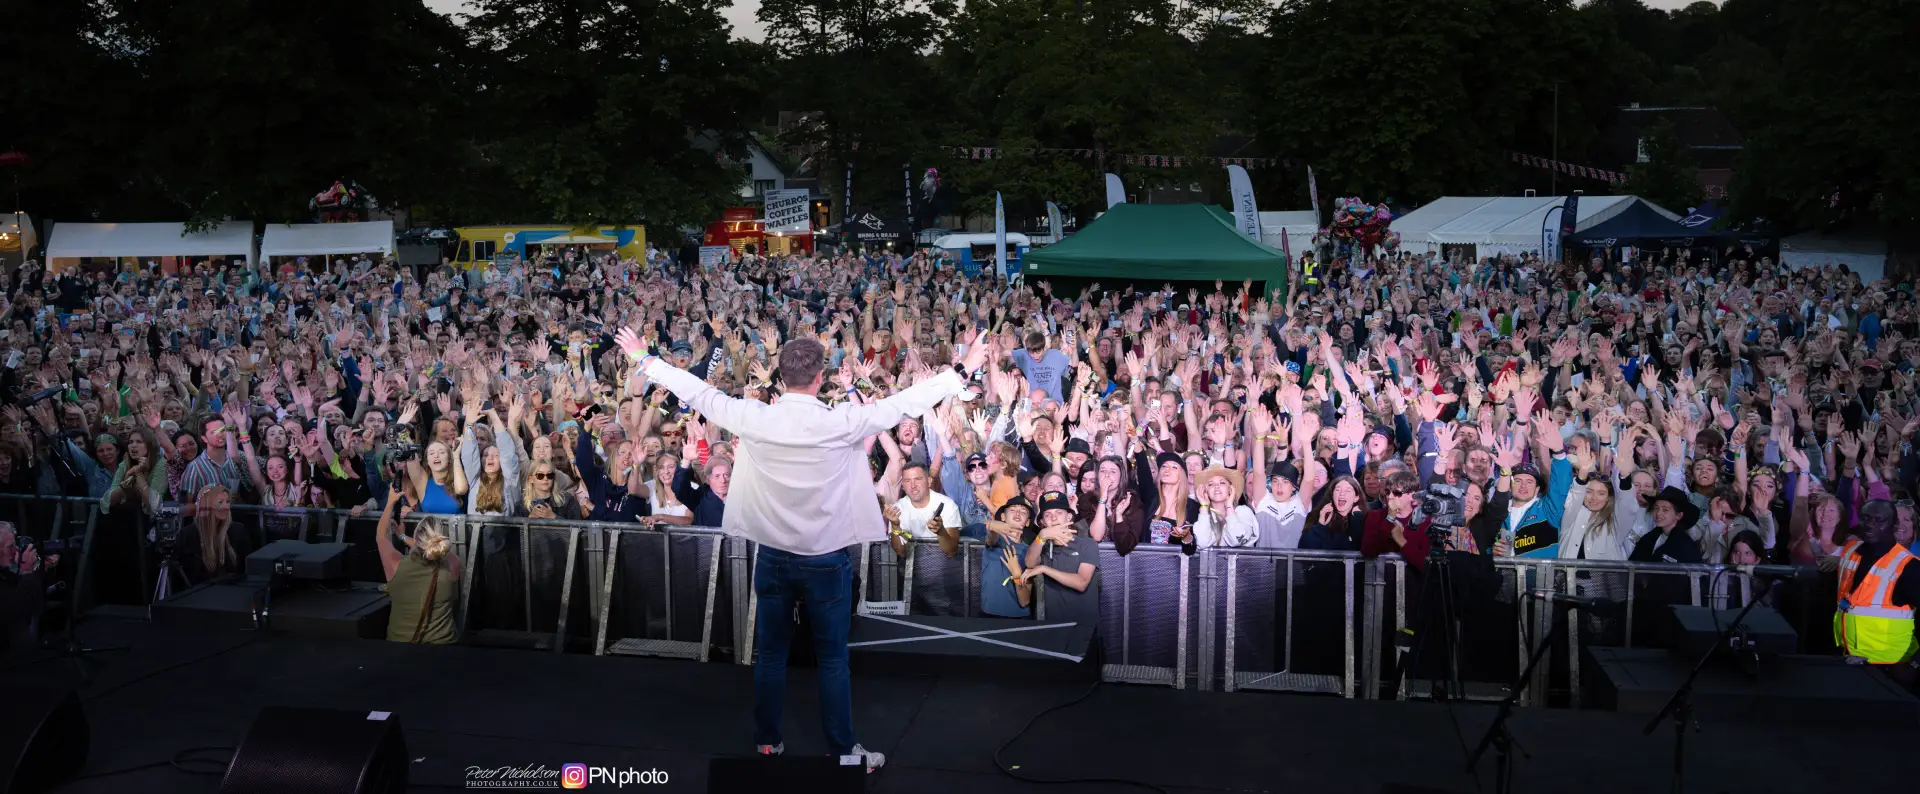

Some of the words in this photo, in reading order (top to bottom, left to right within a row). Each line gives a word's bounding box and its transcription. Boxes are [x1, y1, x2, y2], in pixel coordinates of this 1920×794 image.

[766, 195, 808, 210] CHURROS
[769, 205, 802, 219] COFFEE
[766, 213, 808, 229] WAFFLES
